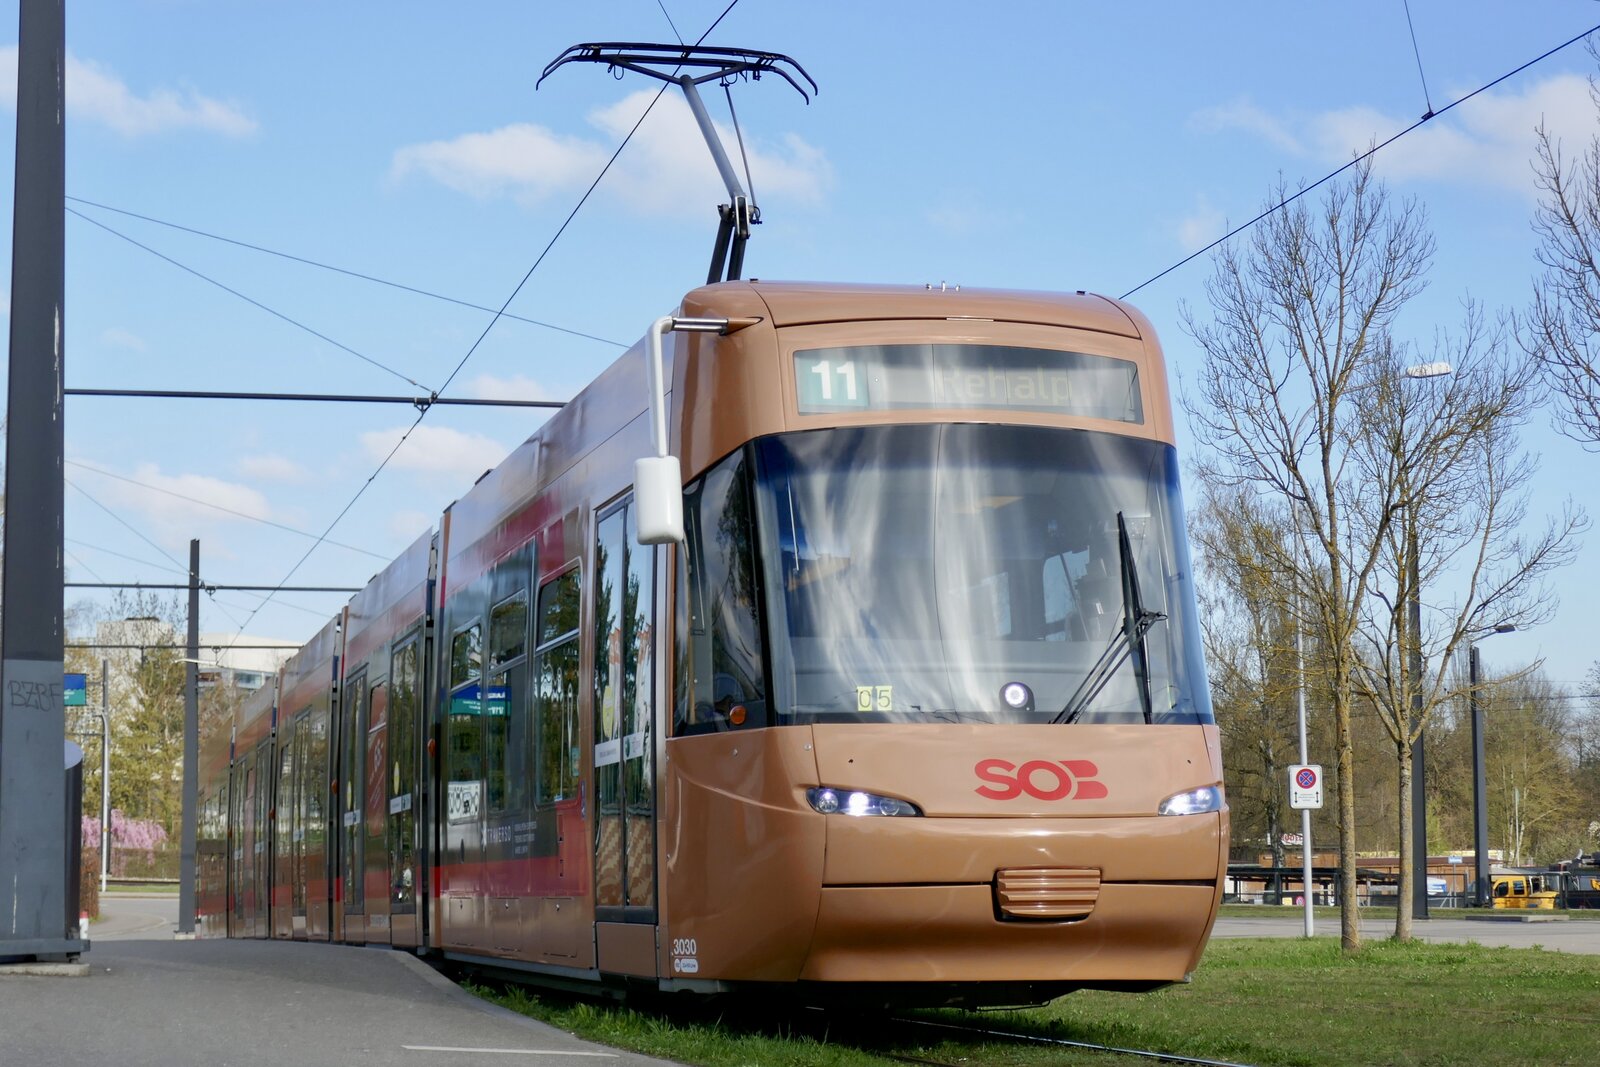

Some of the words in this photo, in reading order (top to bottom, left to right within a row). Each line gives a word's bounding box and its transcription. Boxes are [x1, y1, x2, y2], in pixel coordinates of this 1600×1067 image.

[811, 360, 857, 401] 11
[937, 364, 1073, 406] Rehalp
[858, 688, 892, 709] 05
[974, 758, 1109, 801] SOB
[673, 938, 697, 955] 3030
